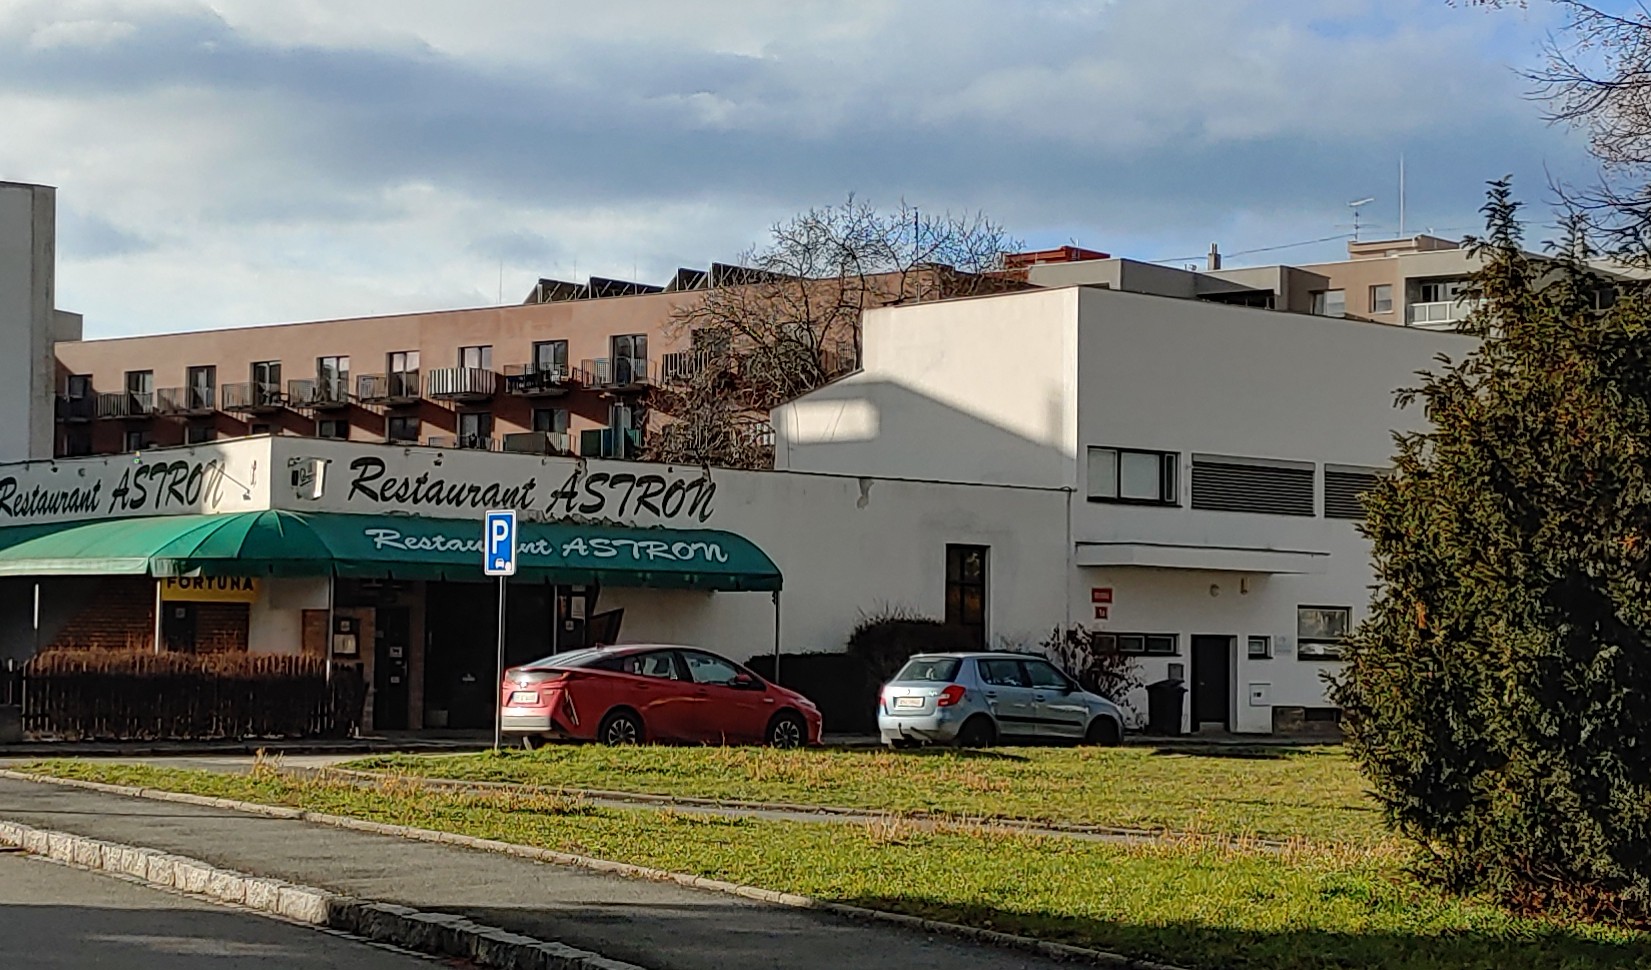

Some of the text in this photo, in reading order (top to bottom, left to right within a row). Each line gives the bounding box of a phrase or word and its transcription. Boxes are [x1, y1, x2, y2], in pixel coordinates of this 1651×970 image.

[0, 459, 225, 518] Restaurant ASTRON
[349, 456, 717, 523] Restaurant ASTRON
[364, 528, 728, 563] Restaunt ASTRON
[492, 519, 509, 554] P
[166, 575, 254, 591] FORTUNA
